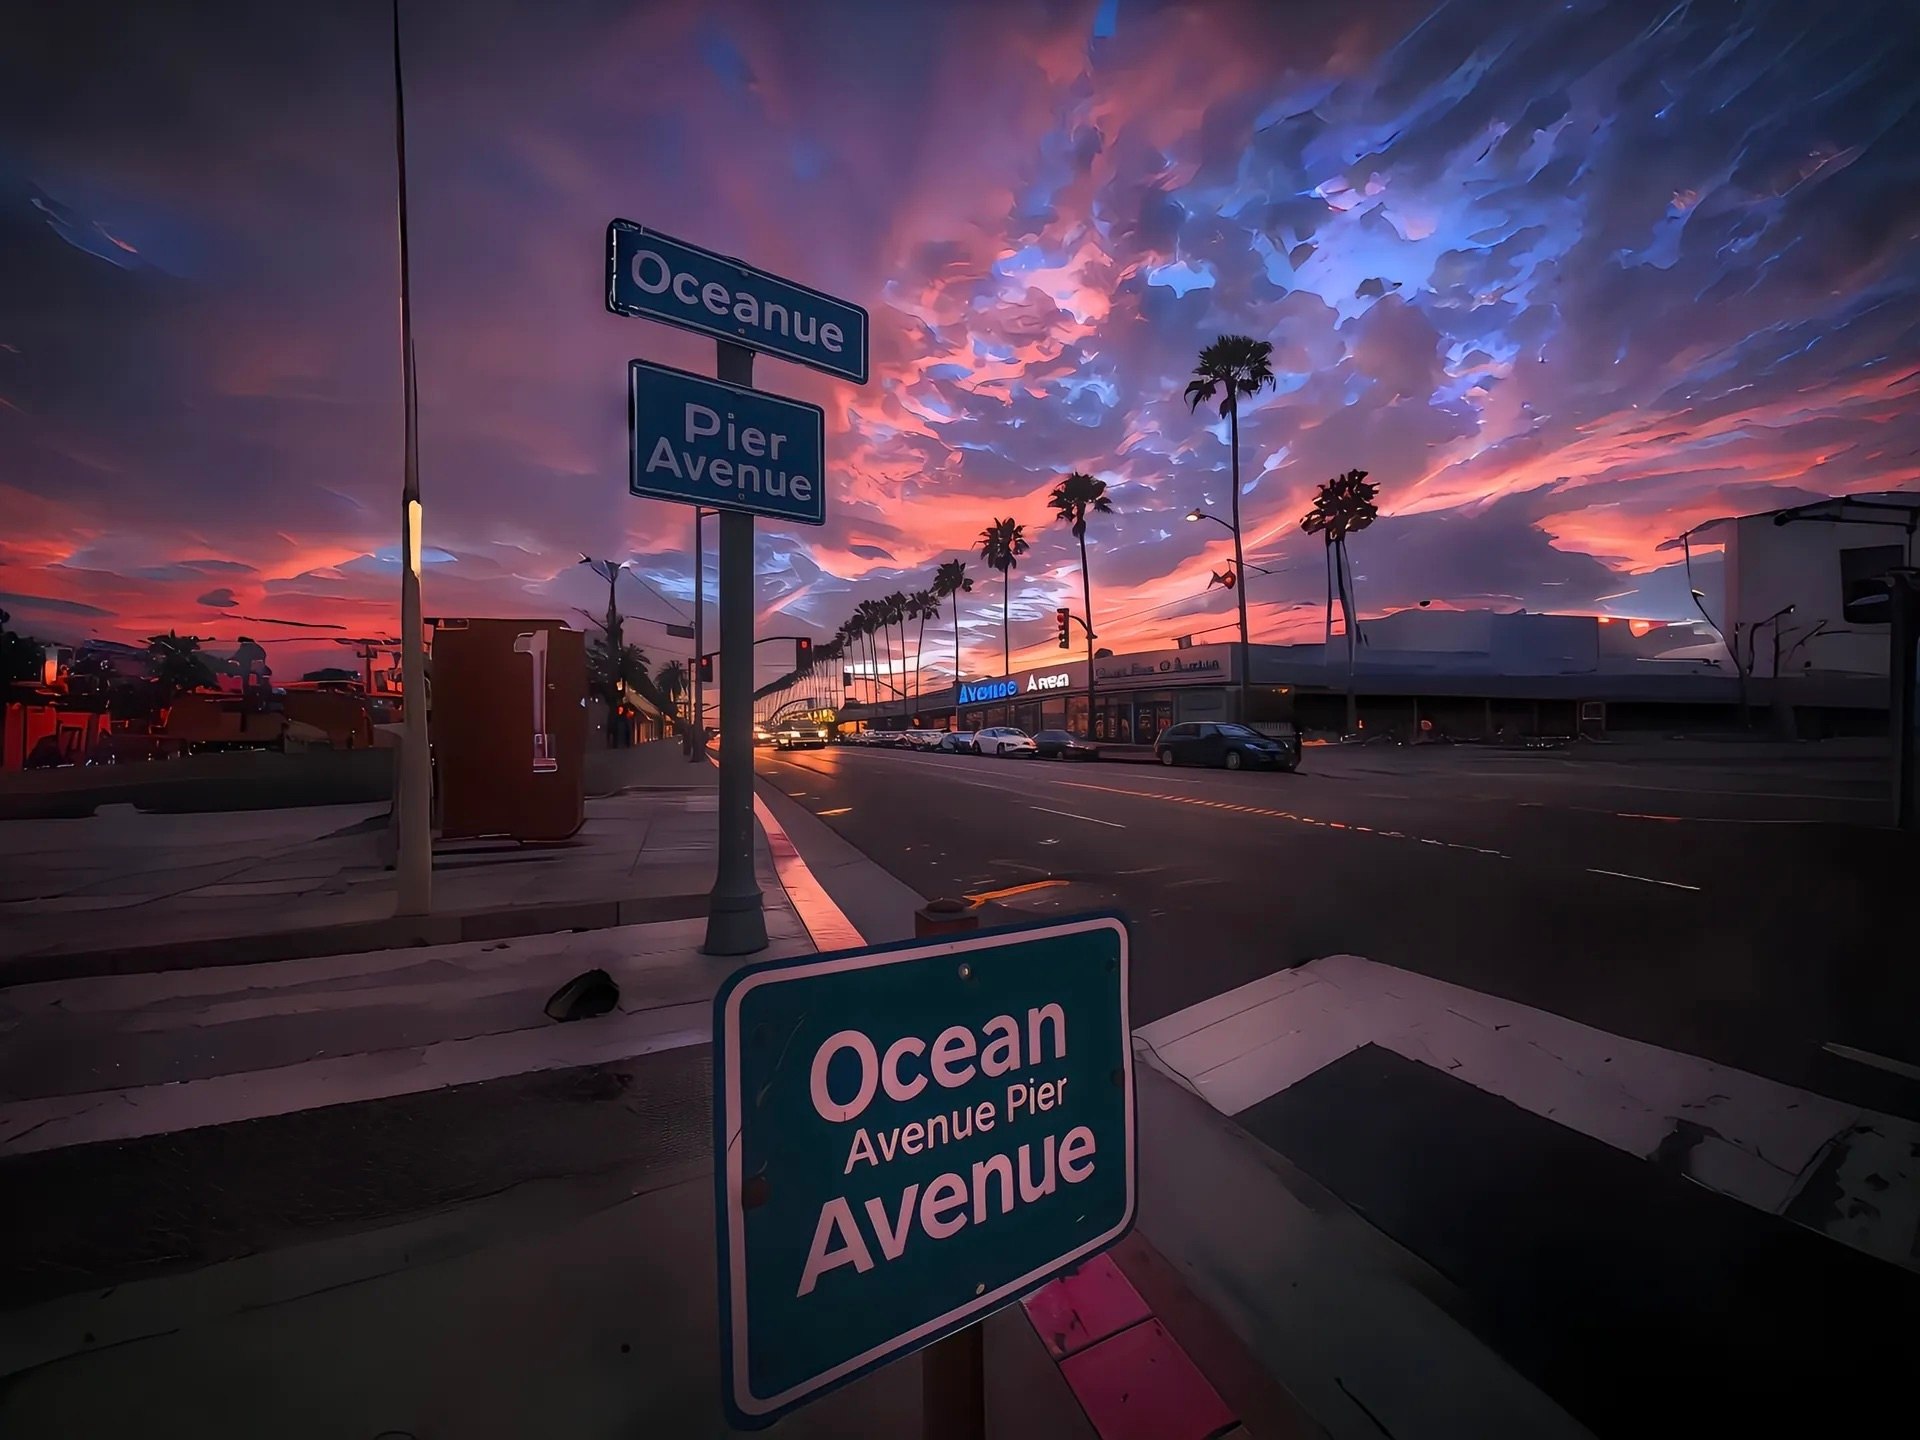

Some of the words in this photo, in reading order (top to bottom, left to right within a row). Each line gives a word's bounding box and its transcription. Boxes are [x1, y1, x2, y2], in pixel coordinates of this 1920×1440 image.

[632, 251, 844, 352] Oceanue
[646, 437, 812, 500] Avenue
[685, 403, 787, 460] Pier
[810, 1003, 1066, 1122] Ocean
[844, 1102, 995, 1174] Avenue
[1008, 1077, 1067, 1122] Pier
[797, 1126, 1096, 1297] Avenue
